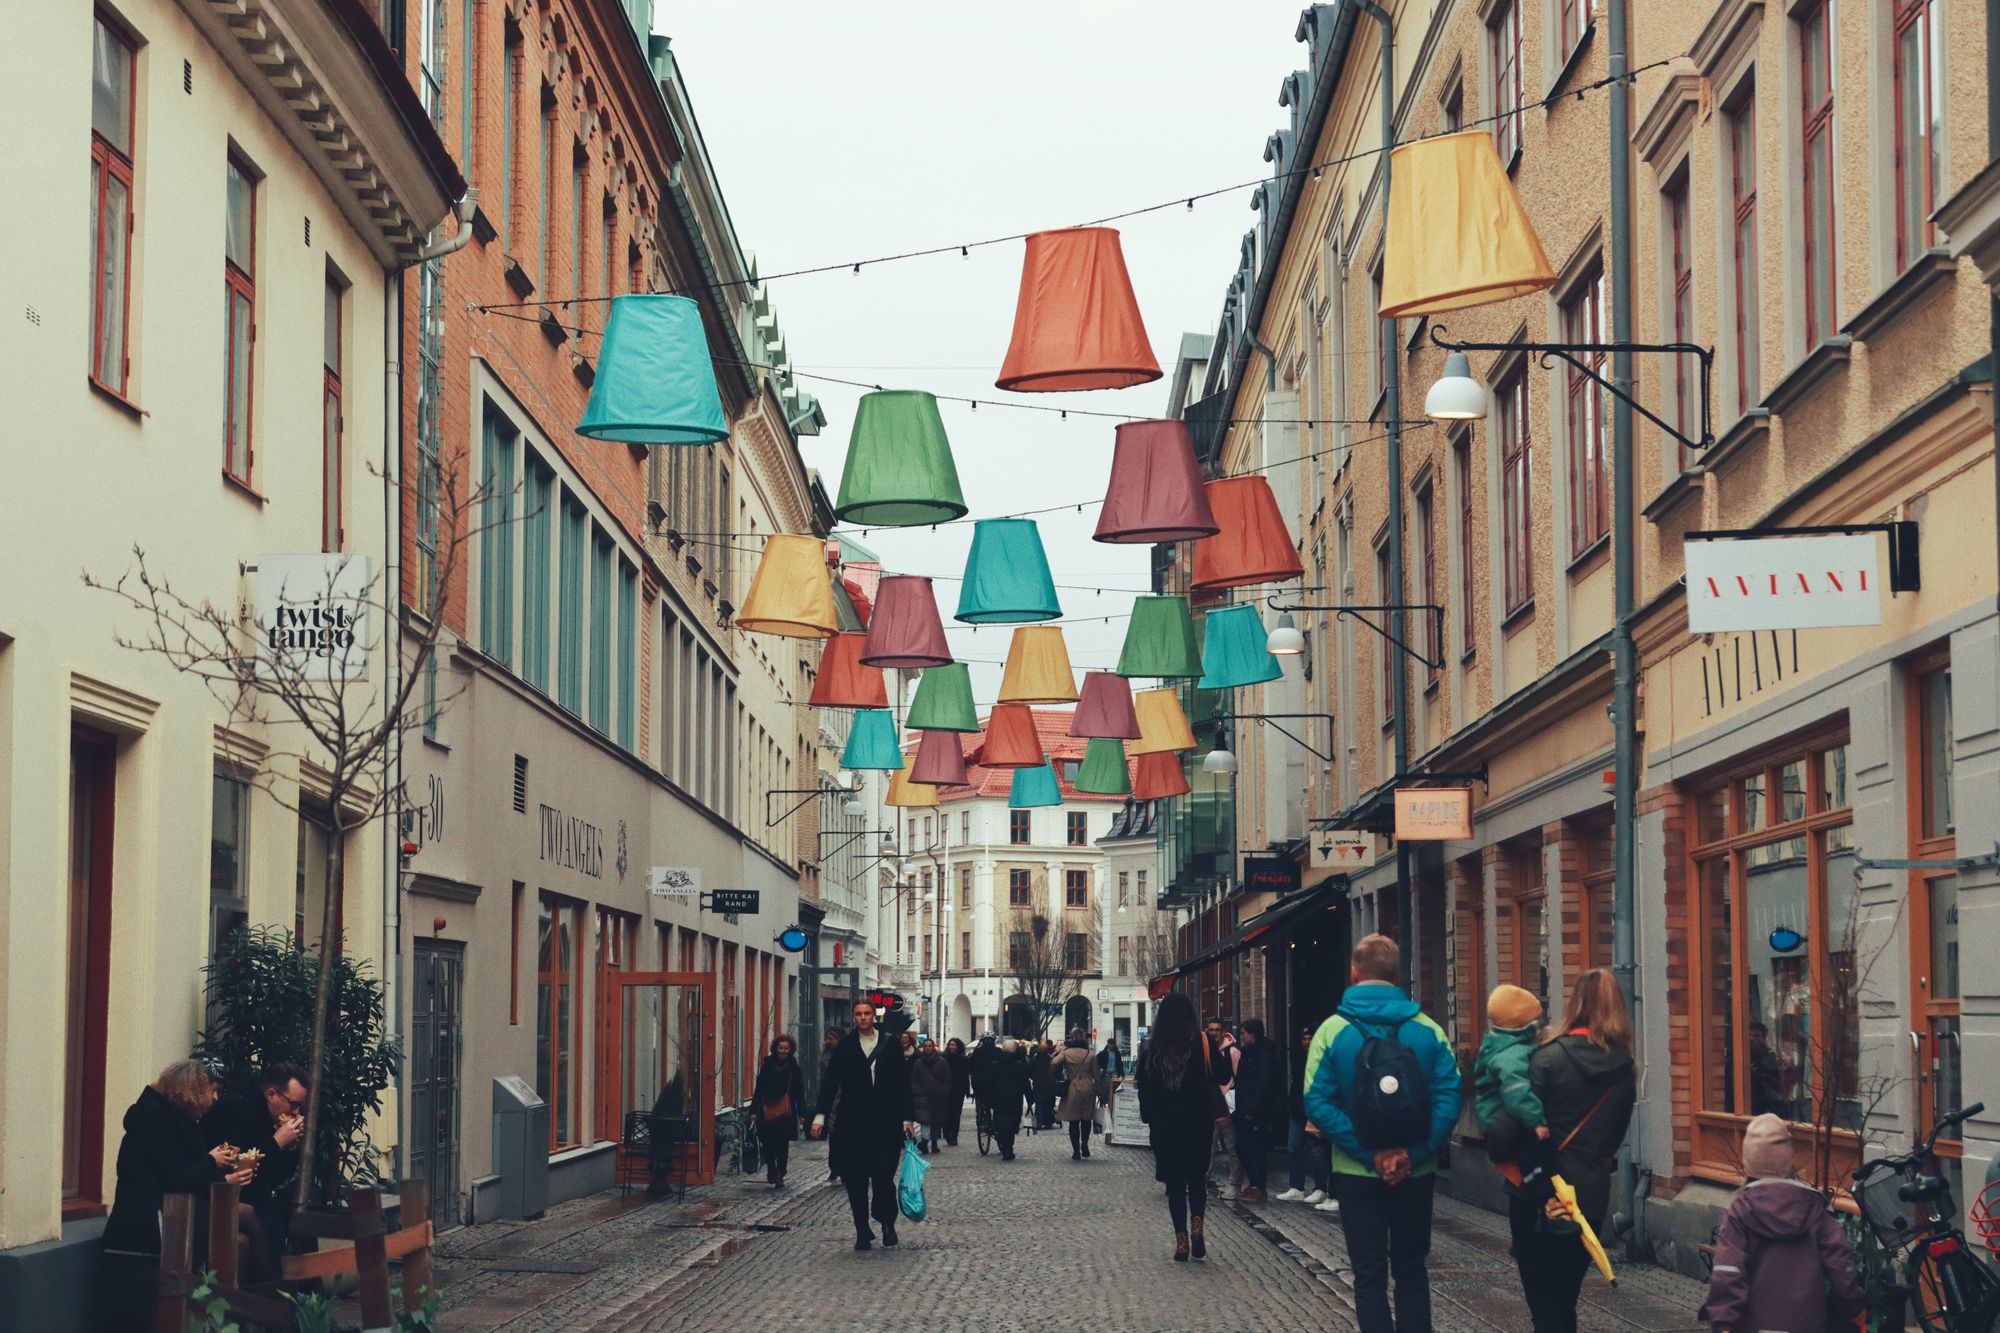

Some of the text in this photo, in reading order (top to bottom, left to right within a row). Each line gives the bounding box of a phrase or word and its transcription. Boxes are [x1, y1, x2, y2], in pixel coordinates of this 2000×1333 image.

[1702, 569, 1868, 598] AVIANI
[276, 599, 347, 628] twist
[268, 626, 355, 658] tango
[427, 773, 444, 843] 30
[540, 803, 603, 880] TWO ANGELS
